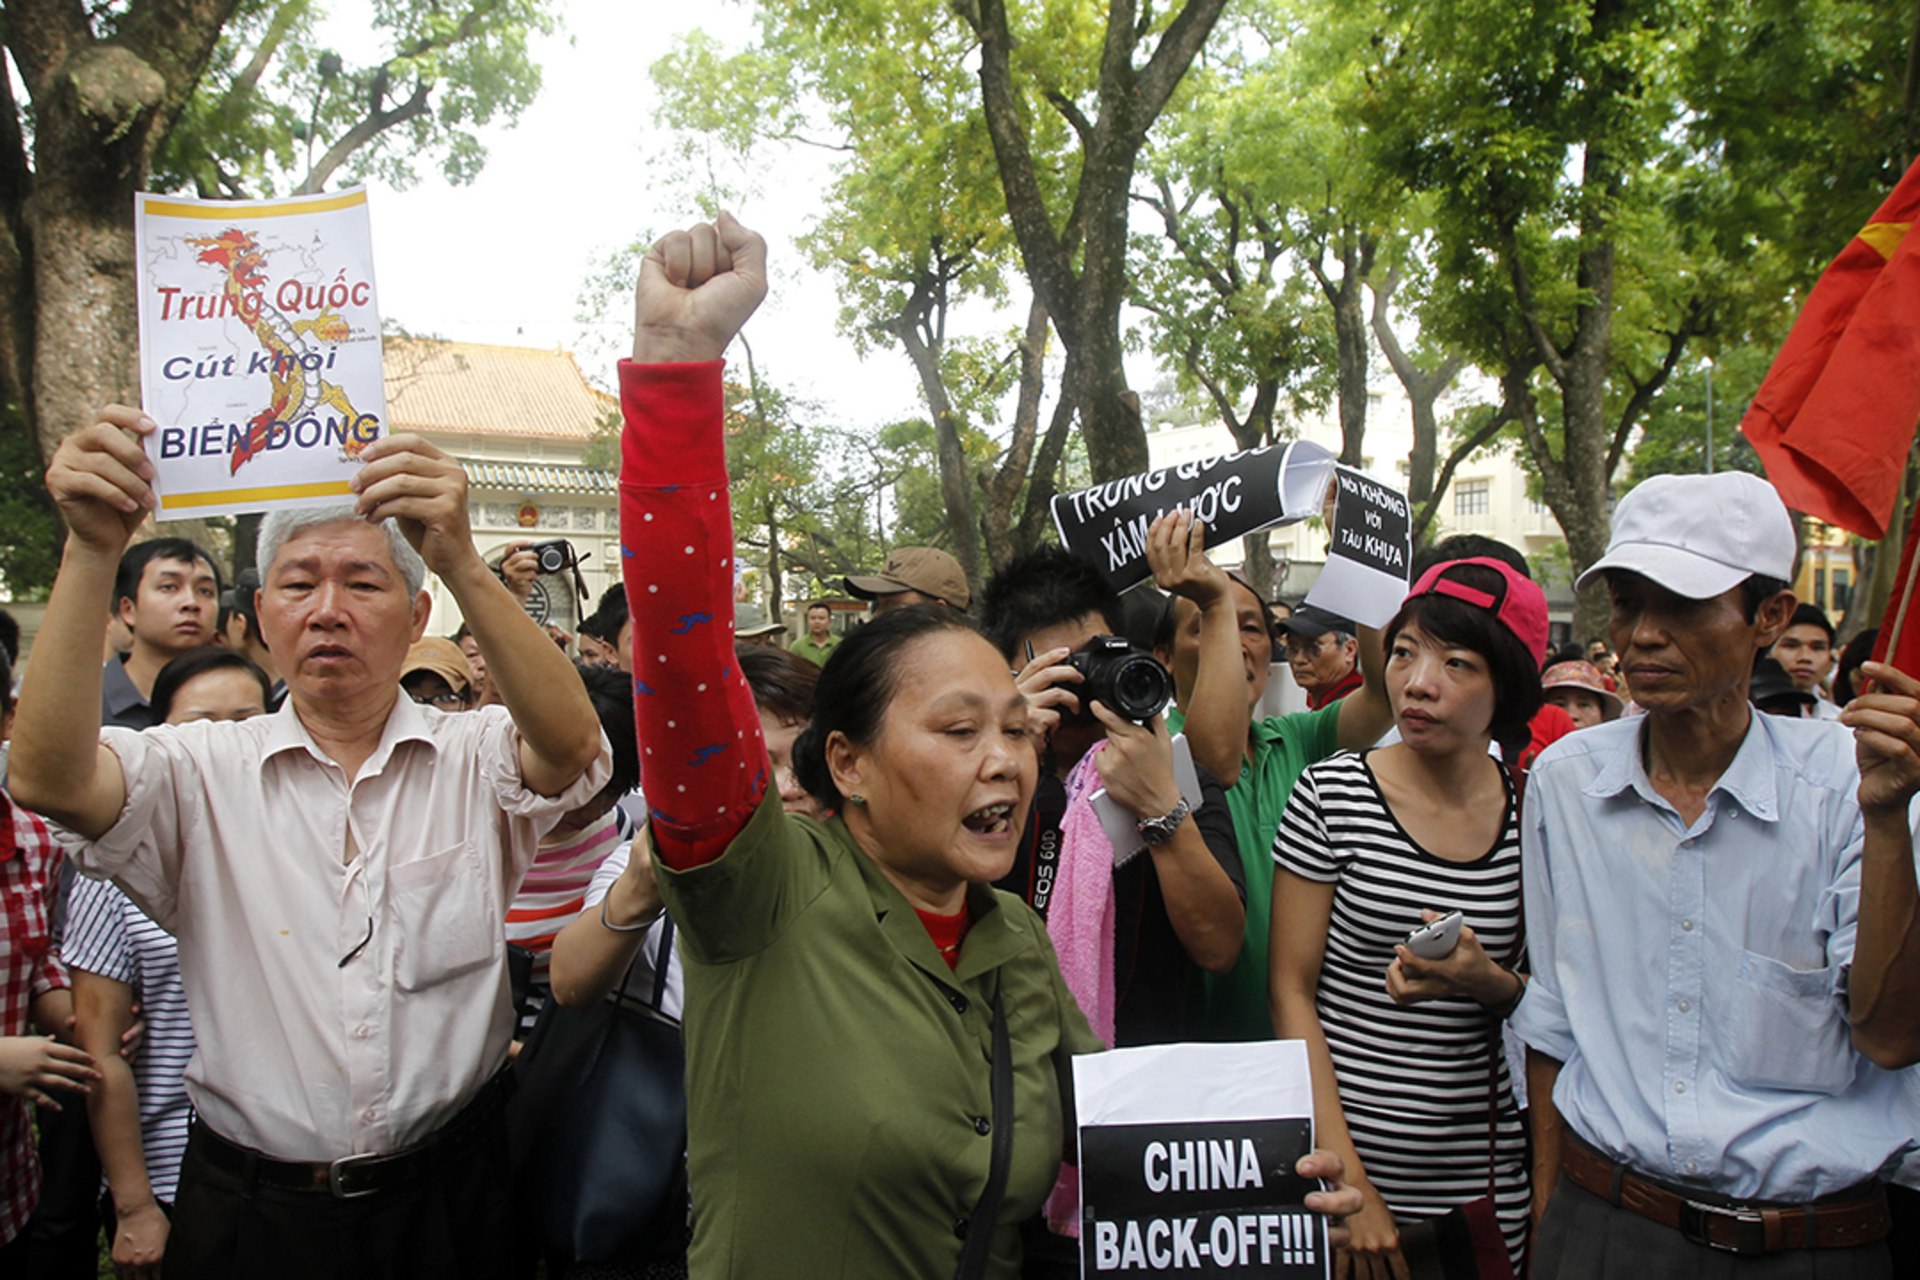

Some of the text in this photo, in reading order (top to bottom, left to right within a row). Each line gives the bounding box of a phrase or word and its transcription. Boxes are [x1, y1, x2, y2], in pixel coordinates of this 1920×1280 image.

[157, 268, 370, 325] Trung Quốc
[162, 353, 235, 380] Cút
[160, 411, 380, 459] BIỂN ĐÔNG
[1068, 471, 1166, 523] TRUNG
[1101, 516, 1148, 572] XÂM
[1342, 528, 1403, 567] TÀU KHỰA
[1034, 829, 1057, 909] EOS 60D
[1144, 1138, 1263, 1193] CHINA
[1095, 1213, 1315, 1271] BACK-OFF!!!
